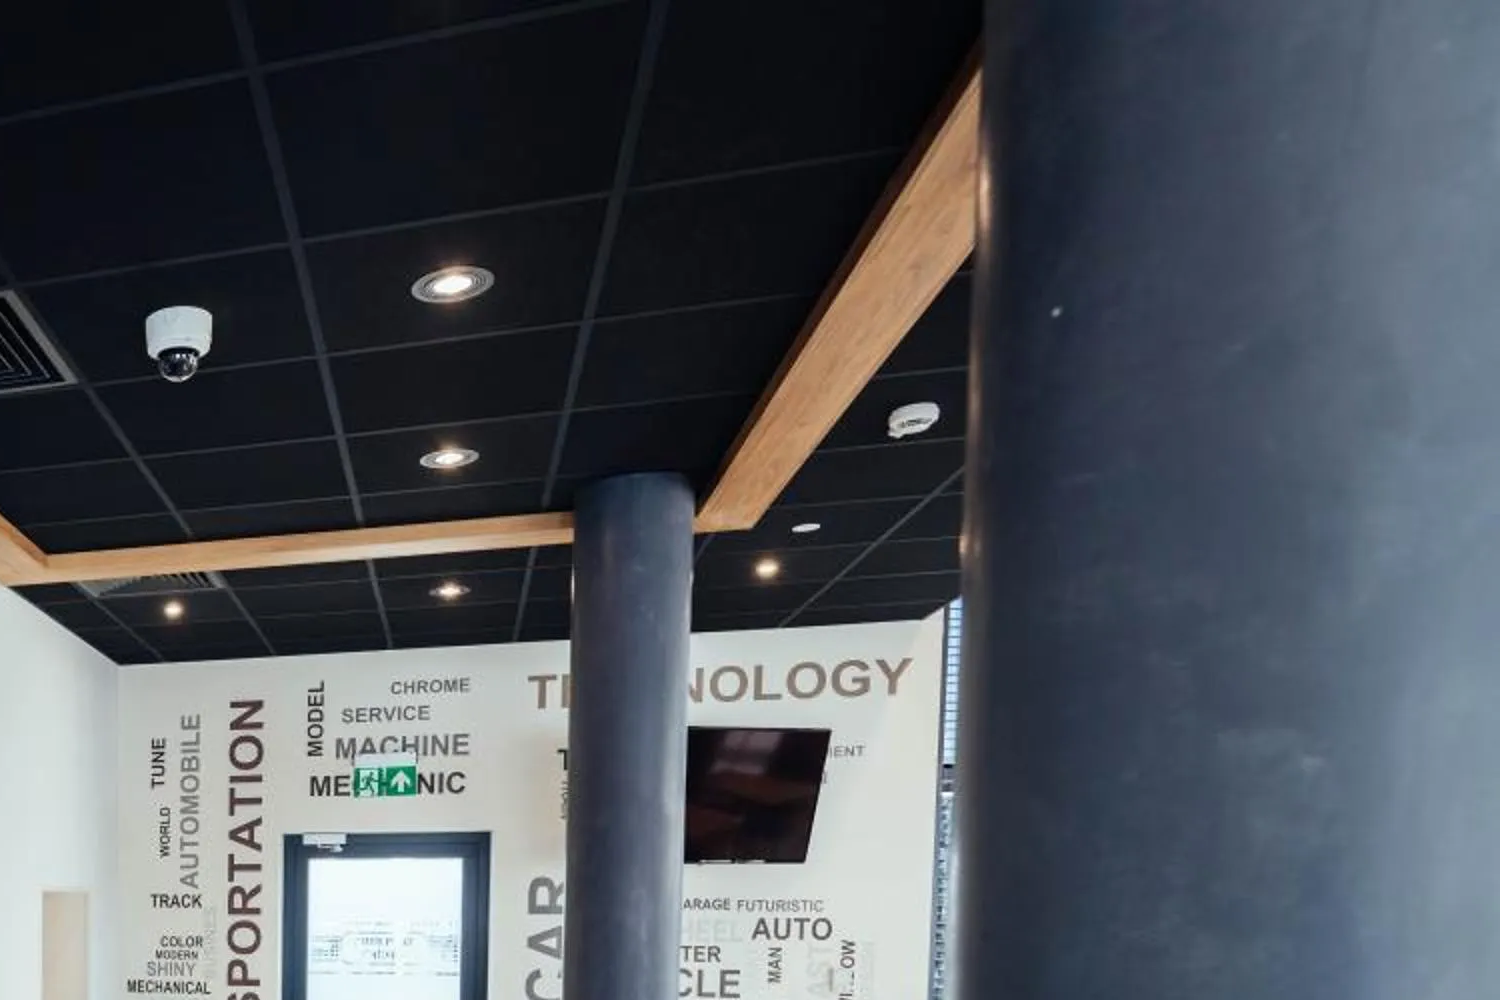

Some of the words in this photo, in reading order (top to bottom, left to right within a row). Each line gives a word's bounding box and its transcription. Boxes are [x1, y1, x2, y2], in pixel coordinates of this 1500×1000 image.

[390, 677, 470, 695] CHROME
[527, 657, 913, 709] TNOLOGY
[307, 680, 325, 757] MODEL
[341, 705, 430, 723] SERVICE
[335, 733, 470, 760] MACHINE
[830, 745, 865, 758] ENT
[151, 737, 166, 789] TUNE
[309, 771, 466, 797] MENIC
[180, 713, 200, 890] AUTOMOBILE
[159, 807, 171, 859] WORLD
[151, 893, 203, 909] TRACK
[682, 898, 731, 911] ARAGE
[737, 899, 825, 913] FUTURISTIC
[751, 917, 833, 941] AUTO
[160, 935, 204, 949] COLOR
[155, 950, 198, 960] MODERN
[680, 945, 721, 963] TER
[147, 960, 196, 978] SHINY
[768, 946, 782, 984] MAN
[127, 979, 212, 996] MECHANICAL
[678, 969, 741, 999] CLE
